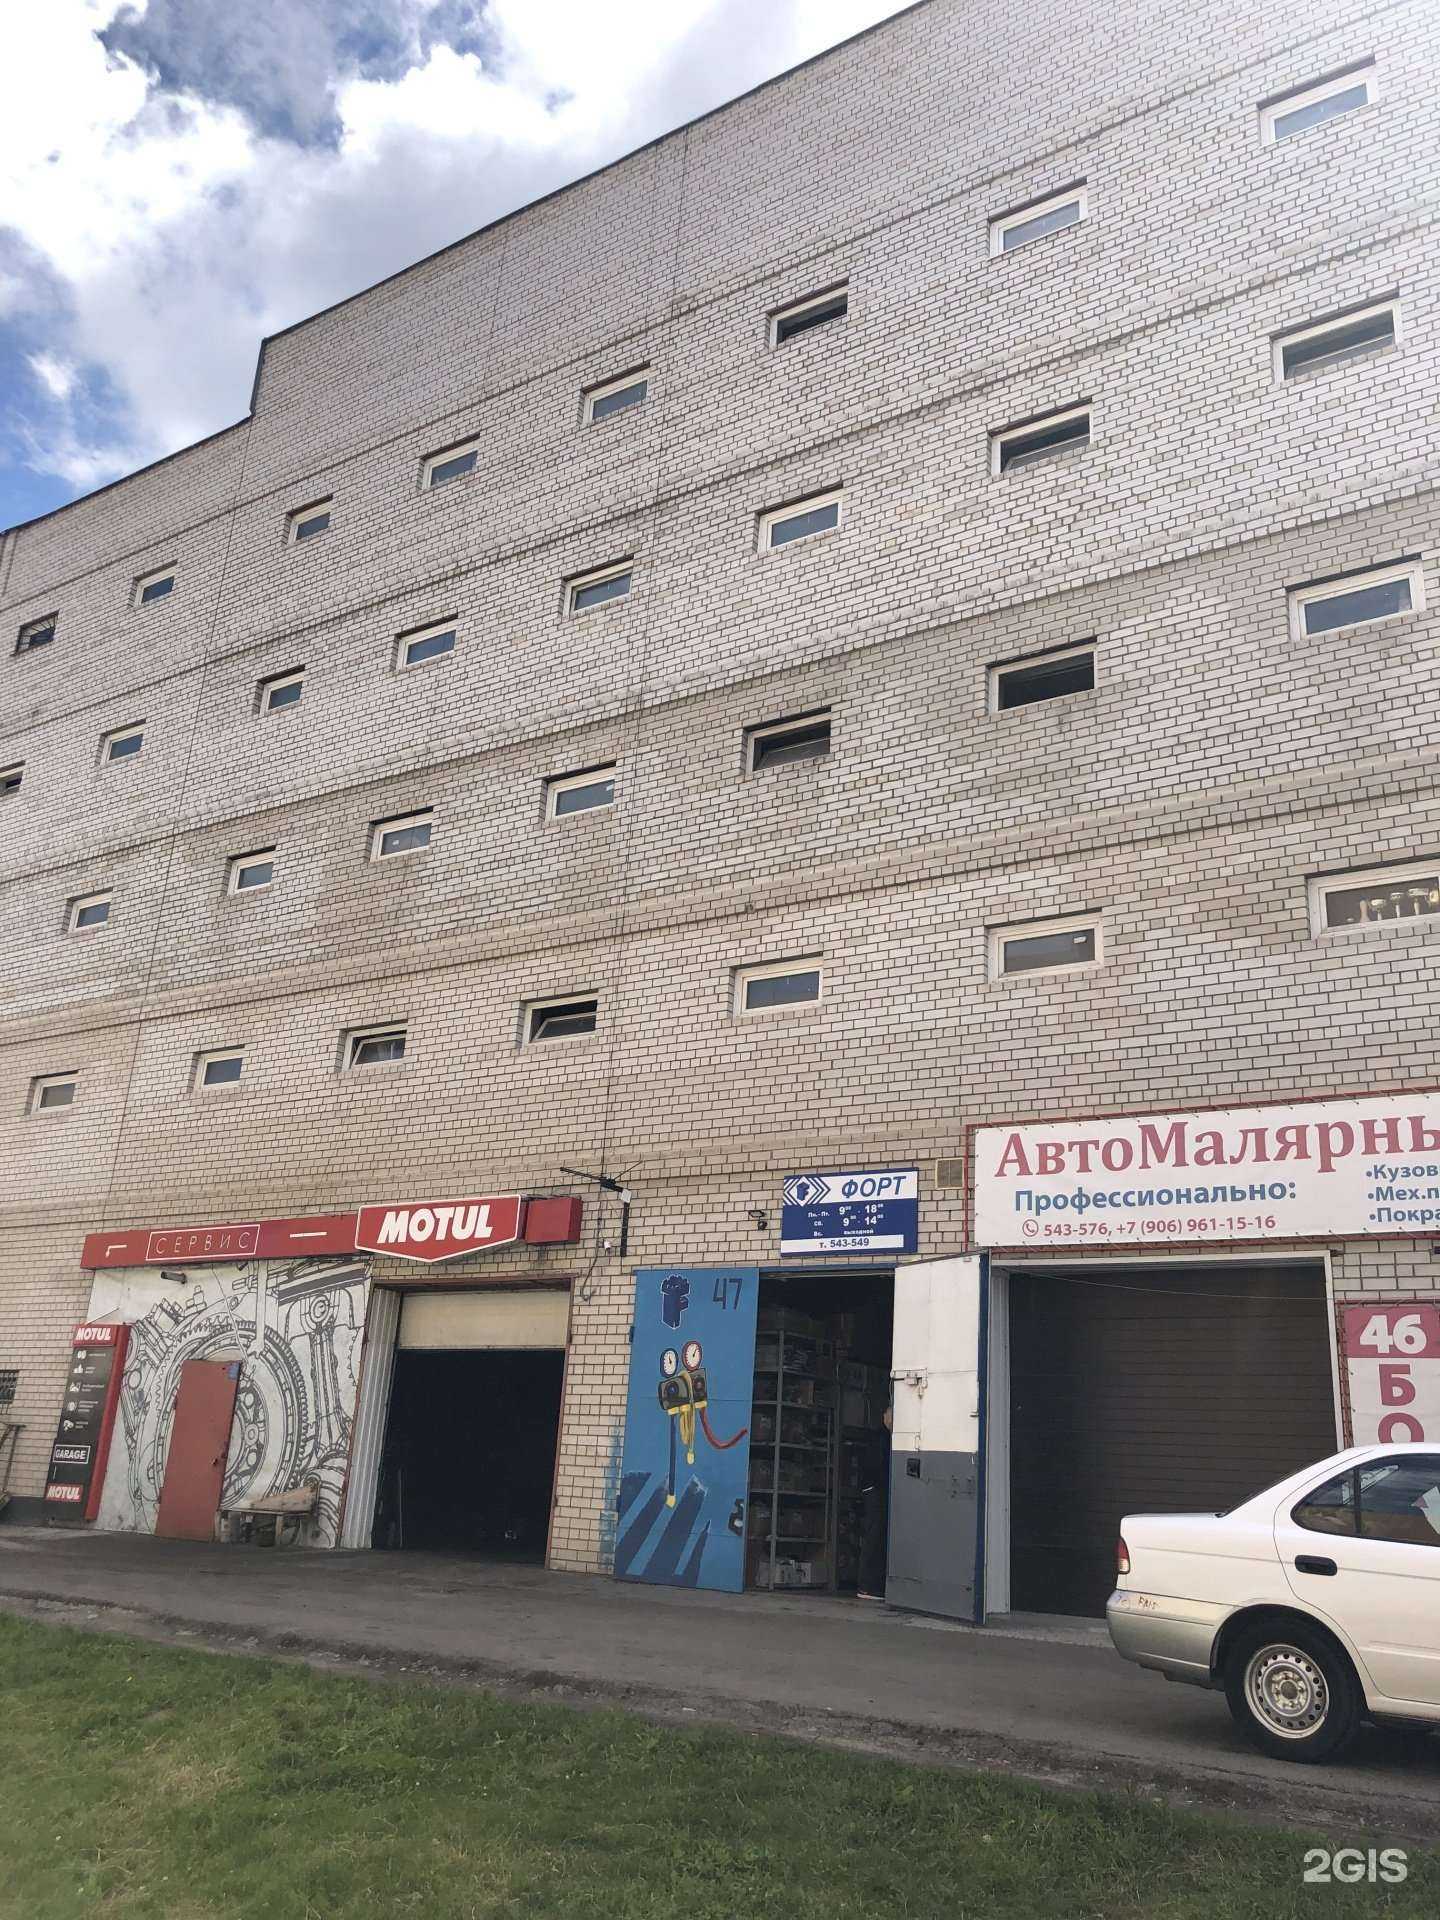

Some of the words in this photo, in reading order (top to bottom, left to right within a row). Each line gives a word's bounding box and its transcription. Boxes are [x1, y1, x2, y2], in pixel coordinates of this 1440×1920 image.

[842, 1176, 907, 1198] ФОРТ
[1015, 1182, 1296, 1216] Профессионально:
[377, 1204, 493, 1244] MOTUL
[1044, 1222, 1112, 1239] 543-576,
[1116, 1221, 1136, 1235] +7
[1141, 1218, 1182, 1236] (906)
[1187, 1215, 1276, 1232] 961-15-16
[155, 1231, 250, 1255] СЕРВИС
[830, 1238, 870, 1248] 543-549
[713, 1278, 743, 1310] 47
[75, 1327, 112, 1341] MOTUL
[1360, 1314, 1427, 1354] 46
[55, 1448, 87, 1460] GARAGE
[47, 1485, 81, 1500] MOTUL
